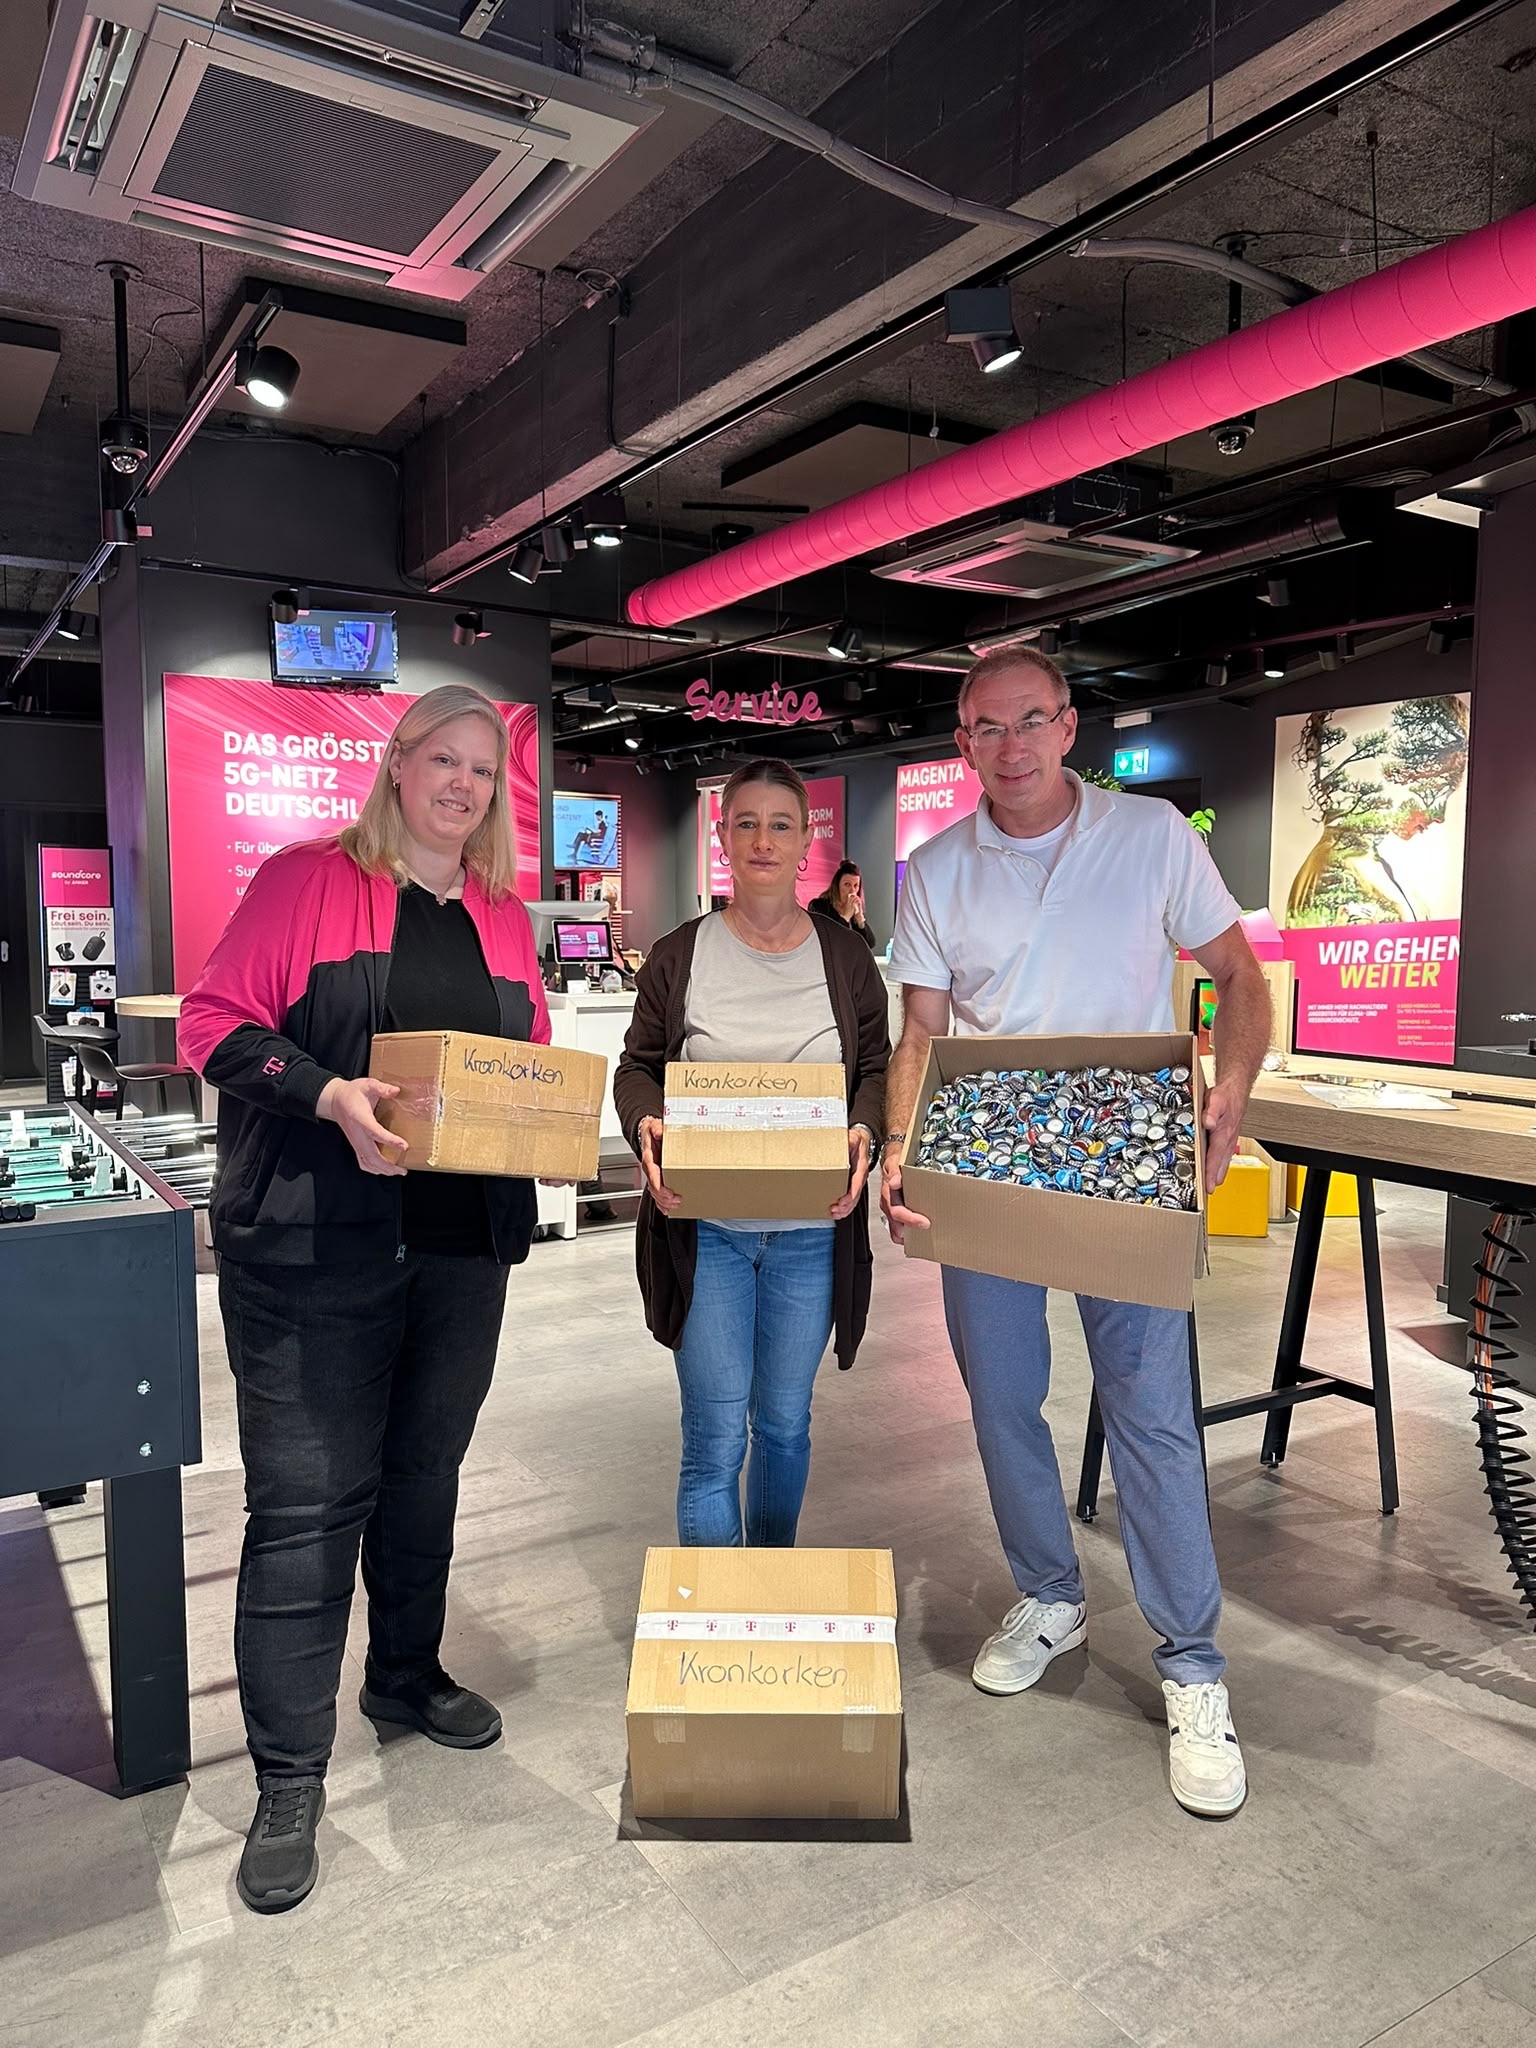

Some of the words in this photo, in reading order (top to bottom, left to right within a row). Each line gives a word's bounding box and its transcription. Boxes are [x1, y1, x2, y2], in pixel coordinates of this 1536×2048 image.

[685, 678, 823, 723] Service
[223, 731, 277, 756] DAS
[283, 731, 388, 763] GRÖSST
[223, 761, 339, 790] 5G-NETZ
[899, 762, 965, 789] MAGENTA
[899, 789, 955, 813] SERVICE
[235, 841, 255, 854] Für
[51, 869, 102, 880] soundcore
[51, 910, 75, 921] Frei
[79, 910, 111, 921] sein.
[1318, 940, 1370, 966] WIR
[1340, 962, 1441, 989] WEITER
[464, 1048, 564, 1086] Kronkorken
[684, 1069, 798, 1093] Kronkorken
[679, 1650, 848, 1688] Kronkorken
